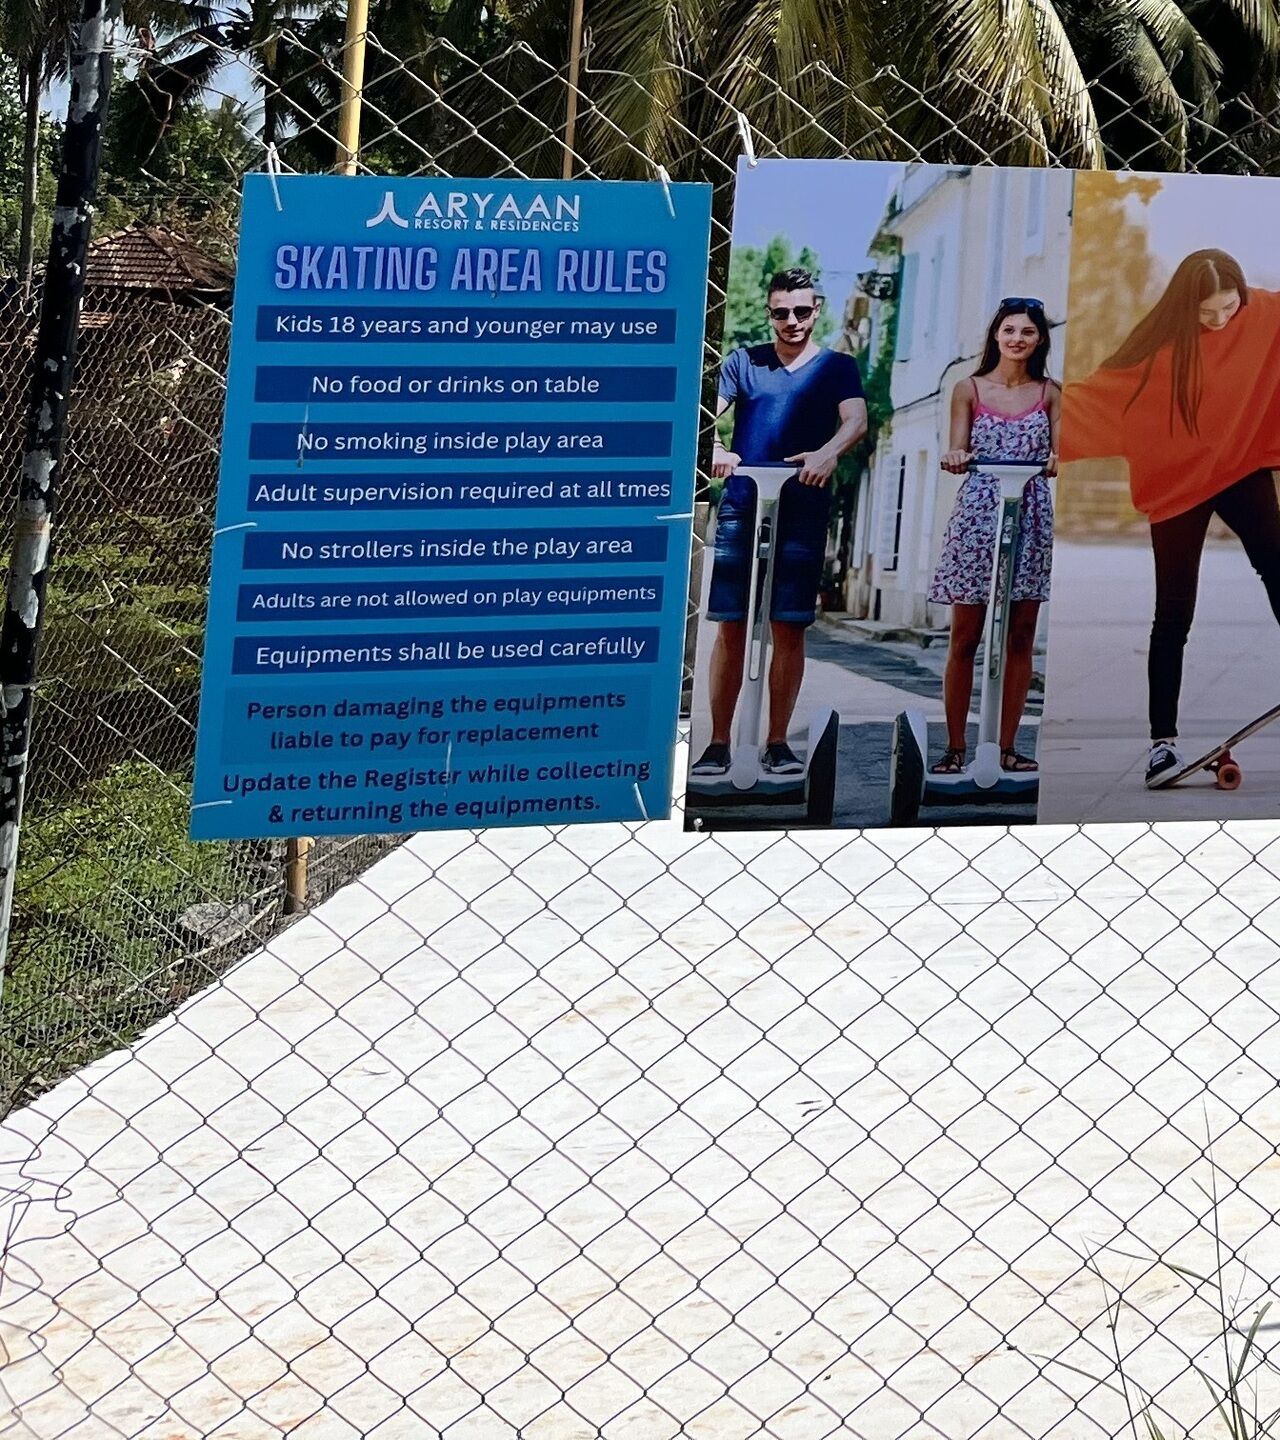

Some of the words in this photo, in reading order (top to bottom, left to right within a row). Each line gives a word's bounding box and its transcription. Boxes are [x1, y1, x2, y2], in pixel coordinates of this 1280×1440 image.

[415, 191, 580, 220] ARYAAN
[415, 218, 469, 230] RESORT
[475, 222, 484, 231] &
[490, 219, 579, 232] RESIDENCES
[276, 246, 437, 290] SKATING
[451, 248, 542, 292] AREA
[558, 250, 666, 292] RULES
[277, 315, 322, 332] Kids
[330, 317, 354, 332] 18
[361, 321, 421, 337] years
[428, 317, 468, 333] and
[475, 321, 565, 338] younger
[571, 322, 615, 338] may
[622, 322, 657, 334] use
[313, 377, 342, 392] No
[351, 376, 401, 392] food
[409, 380, 432, 392] or
[439, 376, 504, 392] drinks
[512, 380, 537, 392] on
[545, 376, 599, 392] table
[298, 432, 328, 450] No
[335, 433, 427, 453] smoking
[434, 432, 498, 449] inside
[506, 432, 550, 453] play
[558, 436, 603, 448] area
[255, 484, 317, 501] Adult
[324, 483, 452, 505] supervision
[461, 481, 553, 503] required
[560, 483, 581, 498] at
[588, 481, 611, 497] all
[619, 483, 669, 497] tmes
[283, 543, 312, 559] No
[320, 541, 413, 558] strollers
[421, 539, 485, 556] inside
[493, 538, 528, 555] the
[535, 538, 580, 559] play
[587, 541, 632, 553] area
[253, 593, 314, 608] Adults
[321, 596, 351, 607] are
[358, 593, 388, 606] not
[394, 590, 467, 605] allowed
[474, 593, 496, 604] on
[503, 589, 541, 606] play
[548, 587, 655, 605] equipments
[257, 646, 391, 668] Equipments
[399, 642, 450, 660] shall
[458, 642, 484, 659] be
[492, 640, 543, 657] used
[551, 637, 645, 658] carefully
[247, 702, 326, 720] Person
[333, 697, 444, 720] damaging
[450, 695, 488, 713] the
[493, 692, 626, 716] equipments
[271, 730, 334, 751] liable
[339, 731, 363, 747] to
[370, 732, 412, 751] pay
[418, 727, 451, 743] for
[456, 722, 600, 746] replacement
[224, 772, 311, 795] Update
[318, 771, 357, 789] the
[365, 767, 461, 791] Register
[469, 764, 529, 783] while
[536, 759, 651, 781] collecting
[268, 805, 284, 823] &
[291, 800, 403, 823] returning
[410, 799, 448, 817] the
[455, 794, 600, 819] equipments.
